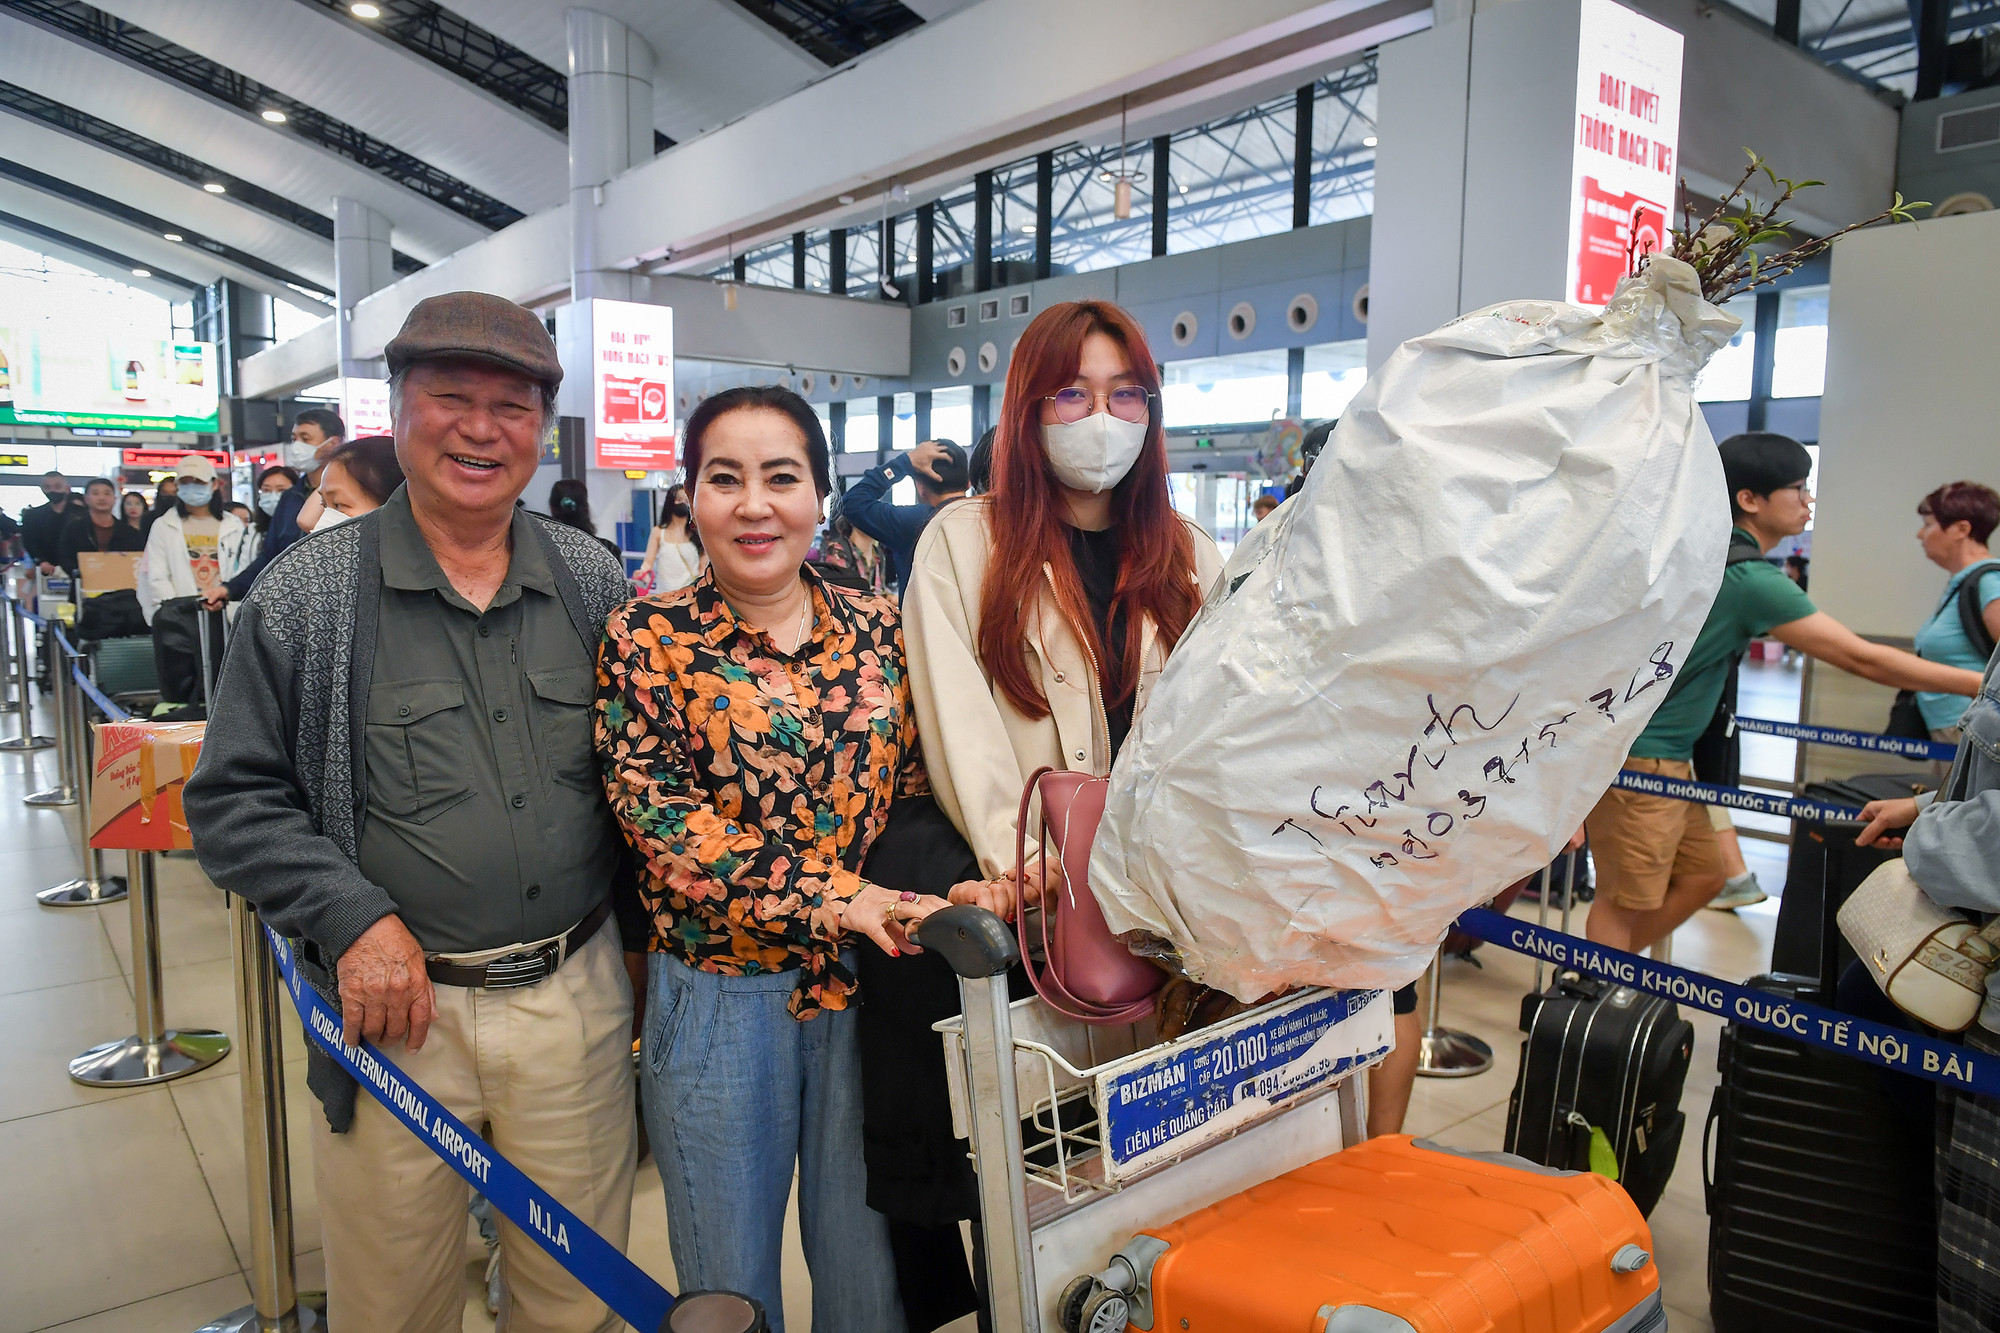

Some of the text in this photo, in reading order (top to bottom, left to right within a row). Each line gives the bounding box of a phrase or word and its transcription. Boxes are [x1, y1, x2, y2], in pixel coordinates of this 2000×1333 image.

[1776, 723, 1819, 741] KHÔNG
[1821, 730, 1857, 746] QUỐC
[1861, 733, 1876, 749] TẾ
[1879, 738, 1903, 753] NỘI
[1905, 740, 1929, 756] BÀI
[1623, 773, 1664, 793] HÀNG
[1666, 782, 1718, 803] KHÔNG
[1721, 791, 1764, 810] QUỐC
[1768, 797, 1789, 816] TẾ
[1511, 928, 1975, 1084] CẢNG HÀNG KHÔNG QUỐC TẾ NỘI BÀI
[1211, 1032, 1267, 1081] 20.000
[1269, 1028, 1278, 1041] XE
[1120, 1062, 1186, 1106] BIZMAN
[1193, 1053, 1210, 1070] CUNG
[310, 1005, 491, 1185] NOIBAI INTERNATIONAL AIRPORT
[1125, 1125, 1151, 1155] LIÊN
[1152, 1120, 1168, 1143] HỆ
[1169, 1107, 1205, 1136] QUẢNG
[528, 1197, 571, 1255] N.I.A
